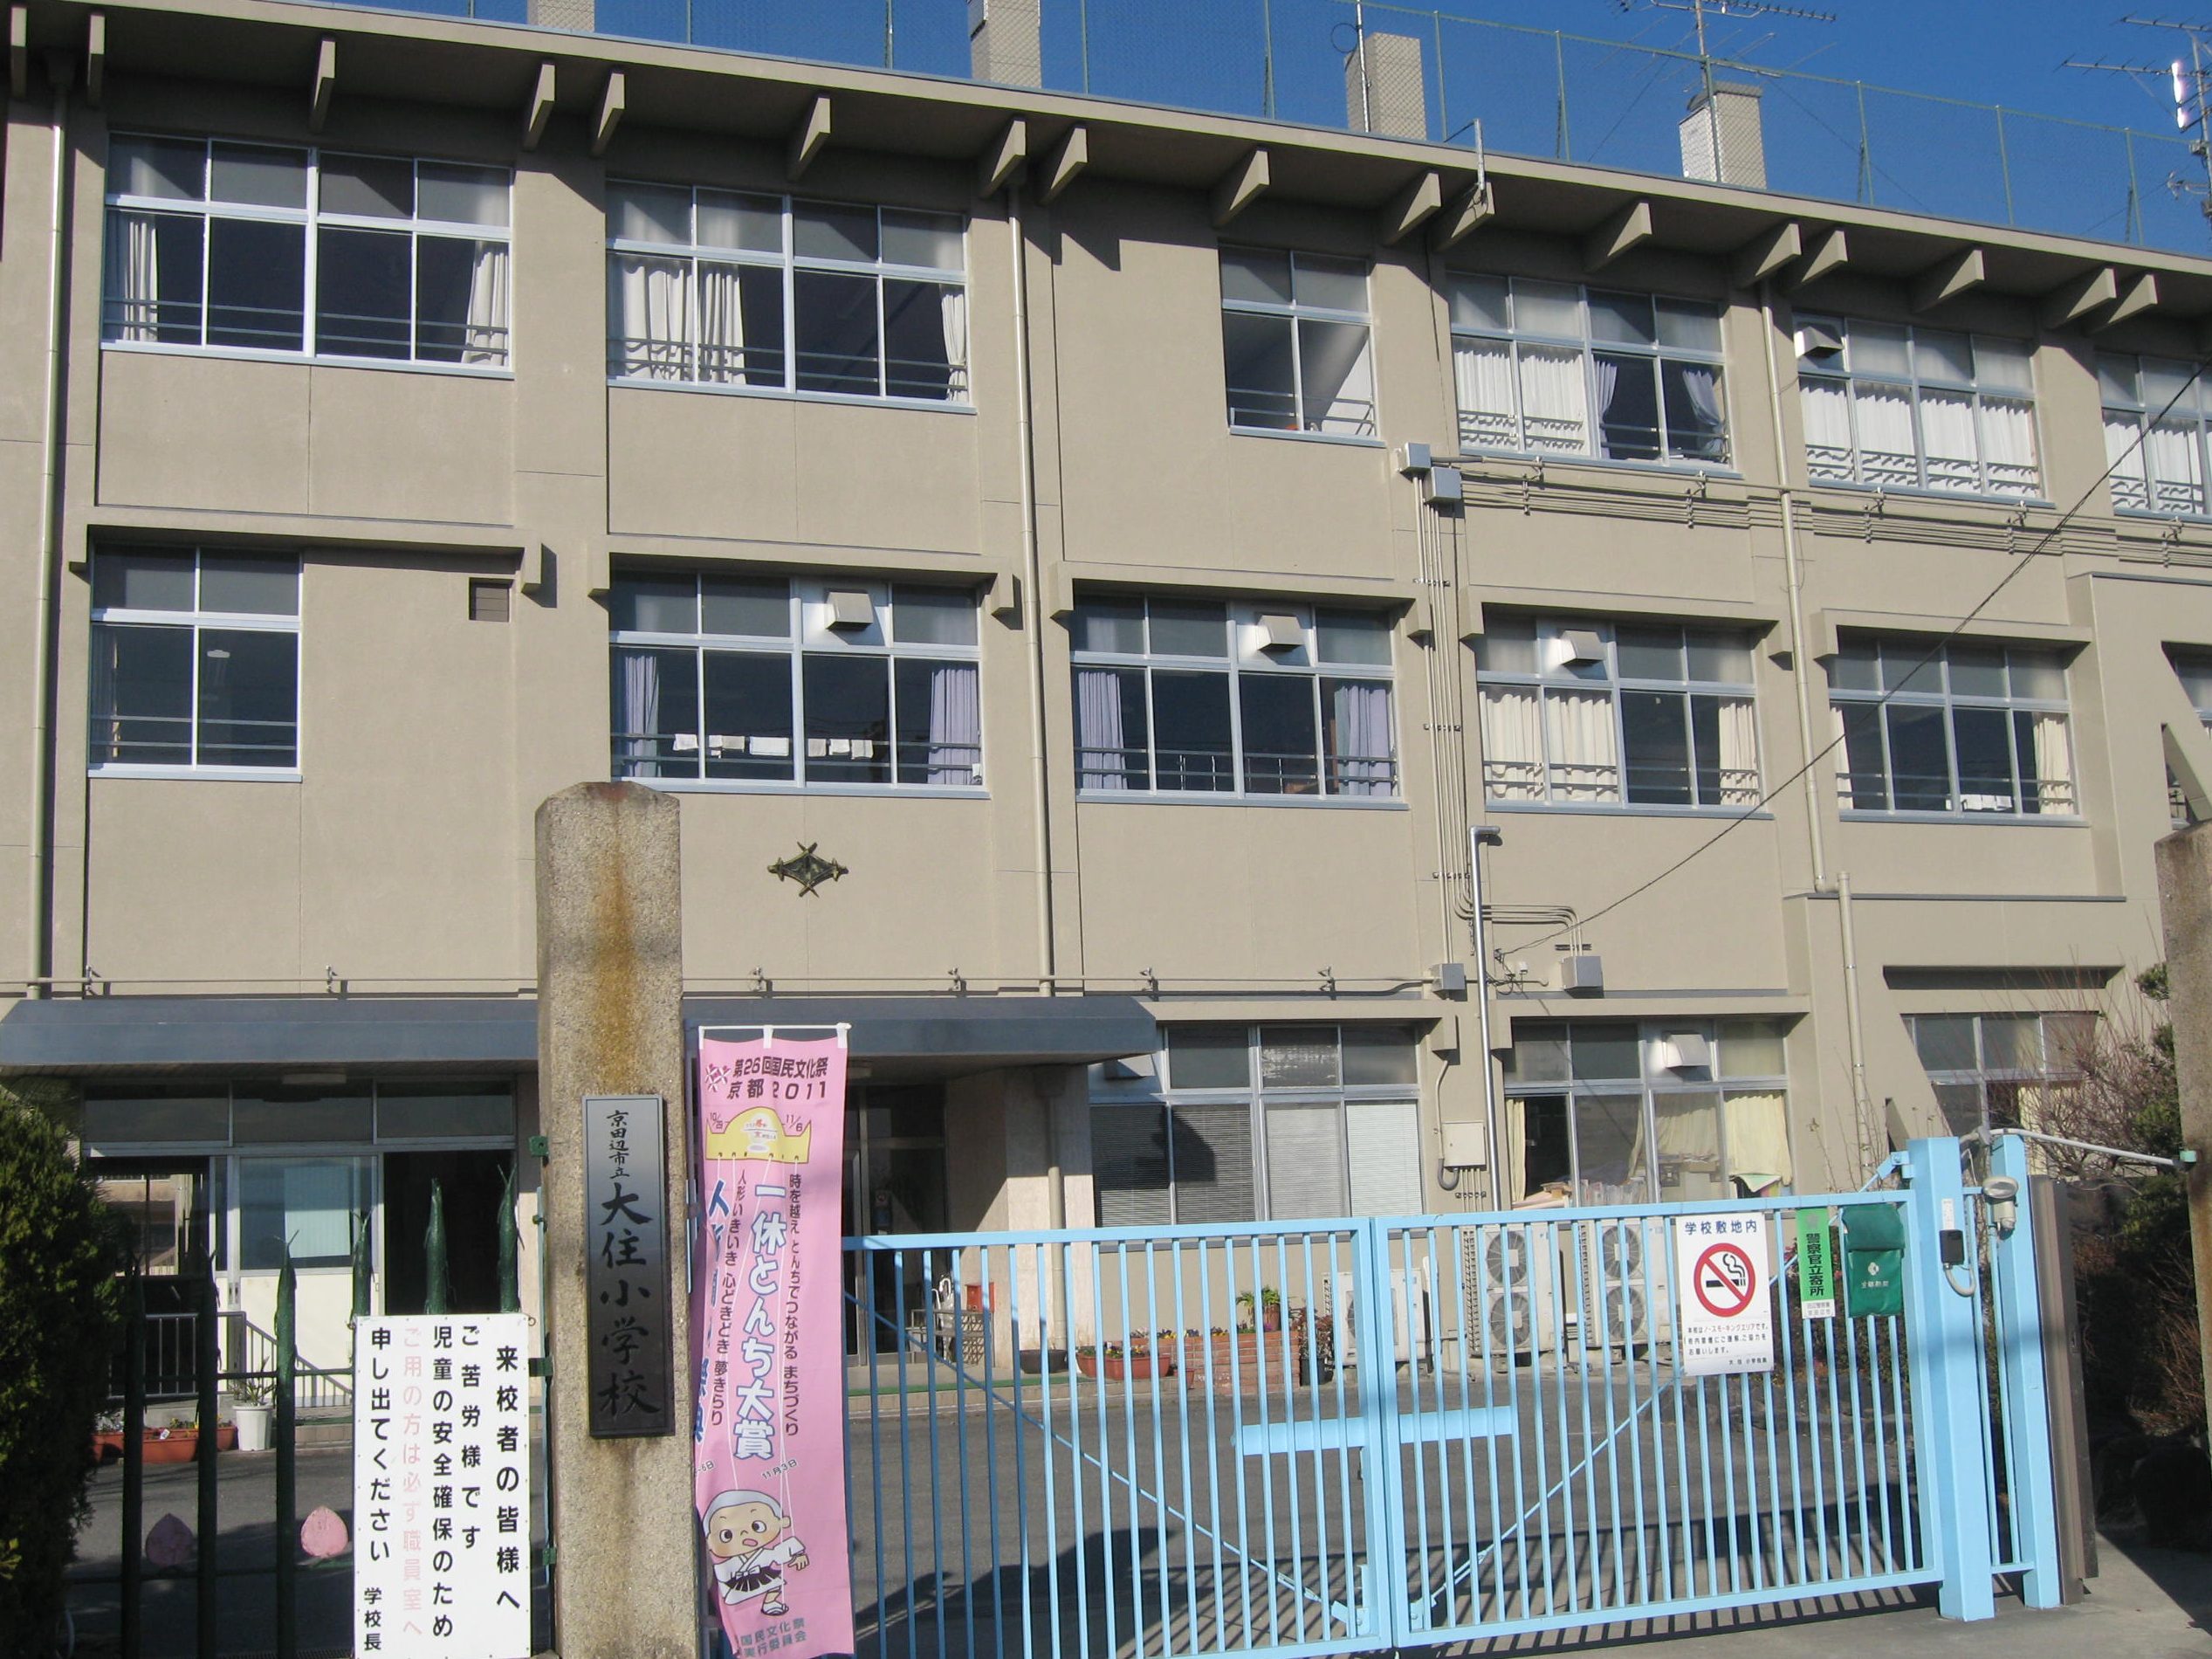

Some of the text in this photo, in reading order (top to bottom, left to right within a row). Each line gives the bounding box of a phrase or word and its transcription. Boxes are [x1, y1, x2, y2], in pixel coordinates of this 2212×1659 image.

[732, 1056, 828, 1079] 第26回国民文化祭
[787, 1114, 803, 1132] 11/6
[606, 1110, 629, 1179] 京田辺市立
[598, 1182, 661, 1417] 大住小学校
[1685, 1219, 1757, 1236] 学校敷地内
[1806, 1232, 1824, 1297] 警察官立寄所
[733, 1184, 787, 1461] 一休とんち大賞
[369, 1326, 391, 1561] 申し出てください
[432, 1325, 453, 1637] 児童の安全確保のため
[461, 1325, 481, 1549] ご苦労様です
[496, 1345, 521, 1609] 来校者の皆様へ
[363, 1587, 382, 1650] 学校長
